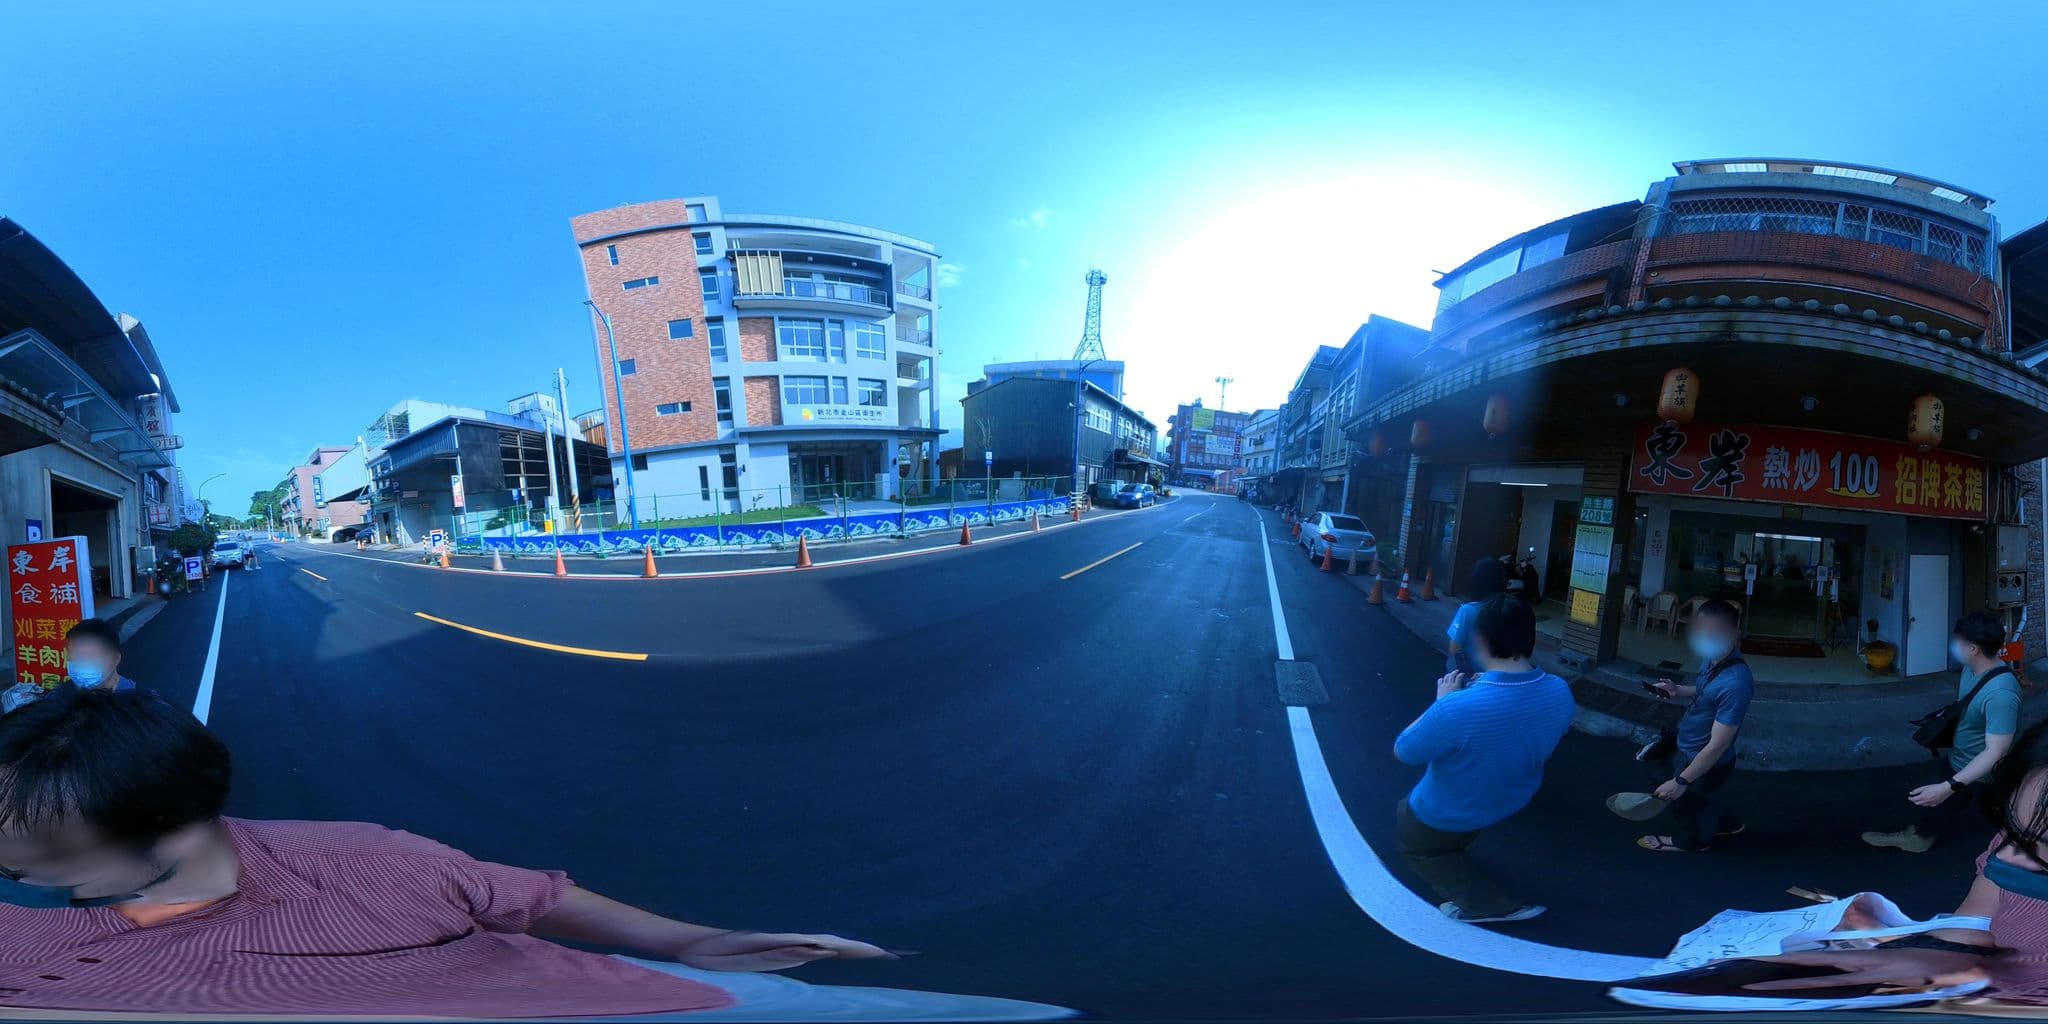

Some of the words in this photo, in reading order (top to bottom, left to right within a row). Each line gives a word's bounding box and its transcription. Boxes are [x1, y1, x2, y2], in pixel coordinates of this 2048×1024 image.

[155, 437, 178, 449] OTEL
[1639, 419, 1751, 497] 東岸
[1894, 454, 1984, 513] 招牌茶鵝
[1582, 509, 1611, 522] 208號
[431, 533, 443, 547] P
[13, 546, 75, 576] 東岸
[186, 560, 200, 574] P
[15, 582, 79, 605] 食補
[18, 644, 70, 669] 羊肉
[20, 670, 71, 690] 九尾
